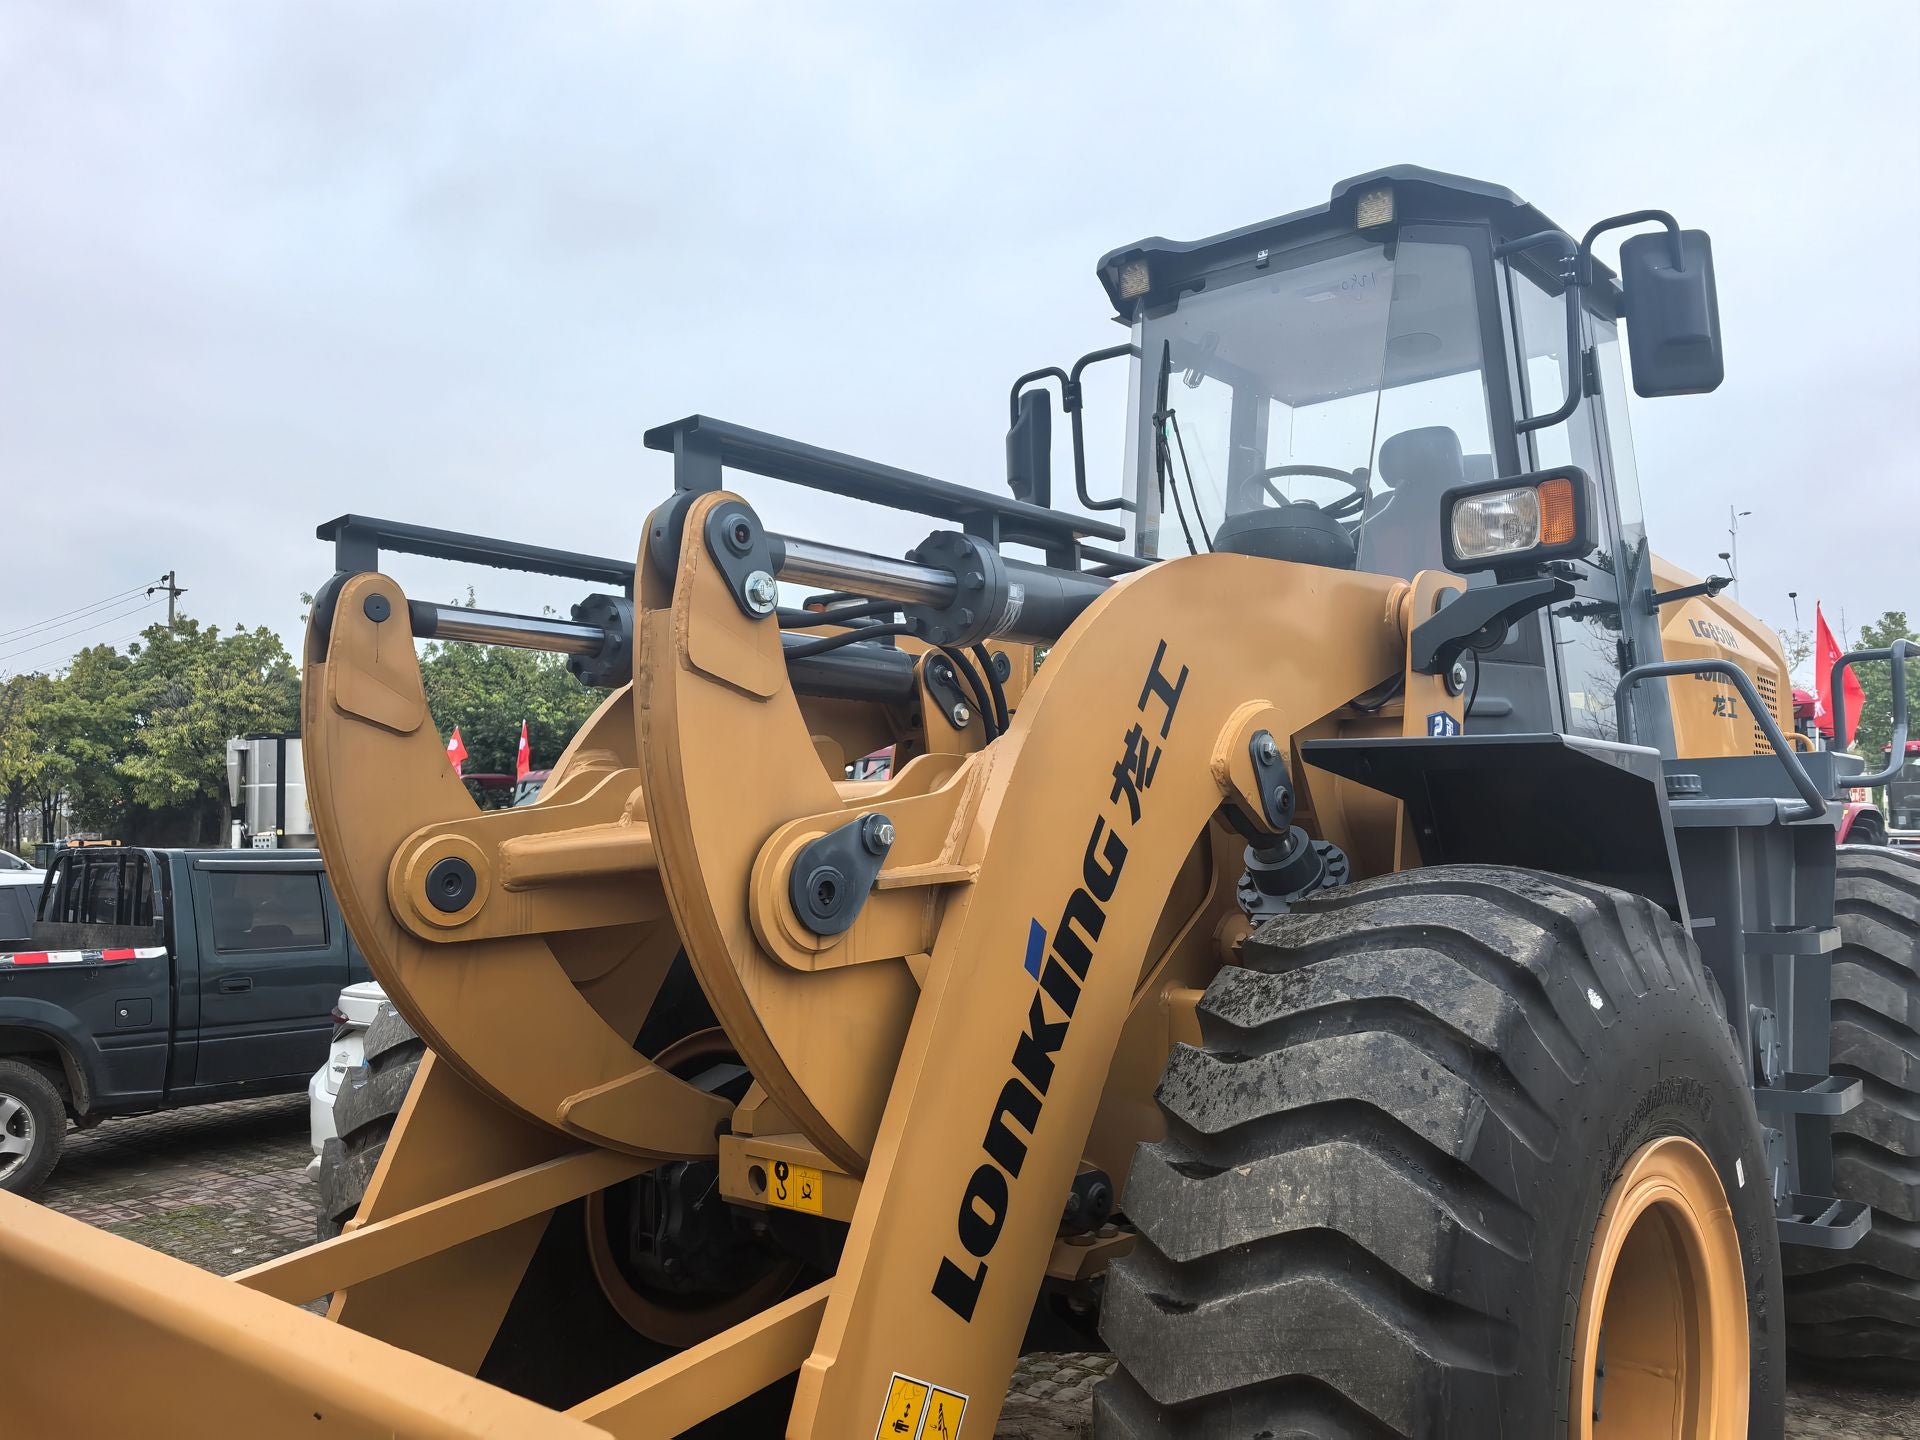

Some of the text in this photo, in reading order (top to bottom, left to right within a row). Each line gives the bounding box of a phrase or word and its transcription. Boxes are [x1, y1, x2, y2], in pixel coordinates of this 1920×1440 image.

[1110, 639, 1189, 825] 龙工
[1712, 694, 1738, 719] 龙工
[931, 815, 1129, 1323] LONKING
